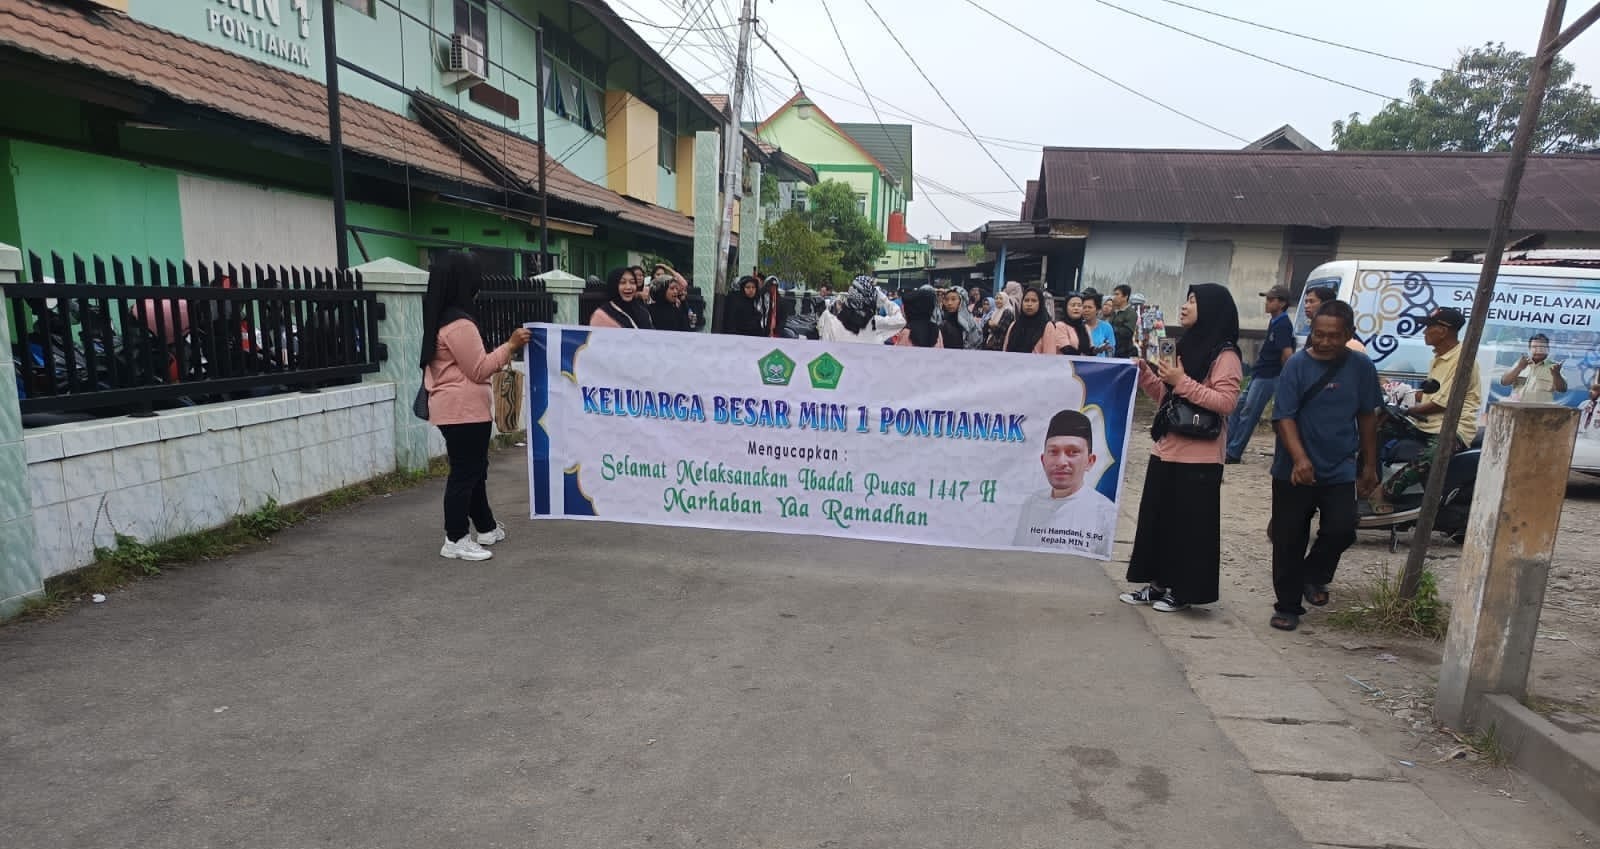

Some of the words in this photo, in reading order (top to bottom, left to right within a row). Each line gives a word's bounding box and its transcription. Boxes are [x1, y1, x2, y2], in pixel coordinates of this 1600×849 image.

[206, 8, 311, 68] PONTIANAK
[1453, 289, 1518, 304] SAUAN
[1455, 306, 1555, 324] EENUHAN
[1559, 313, 1592, 326] GIZI
[581, 385, 706, 423] KELUARGA
[713, 395, 791, 429] BESAR
[799, 401, 848, 433] MIN
[856, 405, 869, 434] 1
[879, 406, 1026, 443] PONTIANAK
[747, 440, 839, 463] Mengucapkan
[601, 454, 667, 481] Selamat
[677, 459, 788, 489] Melaksanakan
[798, 467, 854, 493] Ibadah
[864, 472, 916, 503] Puasa
[928, 478, 970, 502] 1447
[979, 479, 997, 504] H
[663, 487, 762, 515] Marhaban
[776, 496, 810, 518] Yaa
[822, 498, 929, 529] Ramadhan
[1030, 526, 1047, 535] Heri
[1041, 536, 1066, 545] Kepala
[1068, 537, 1083, 547] MIN
